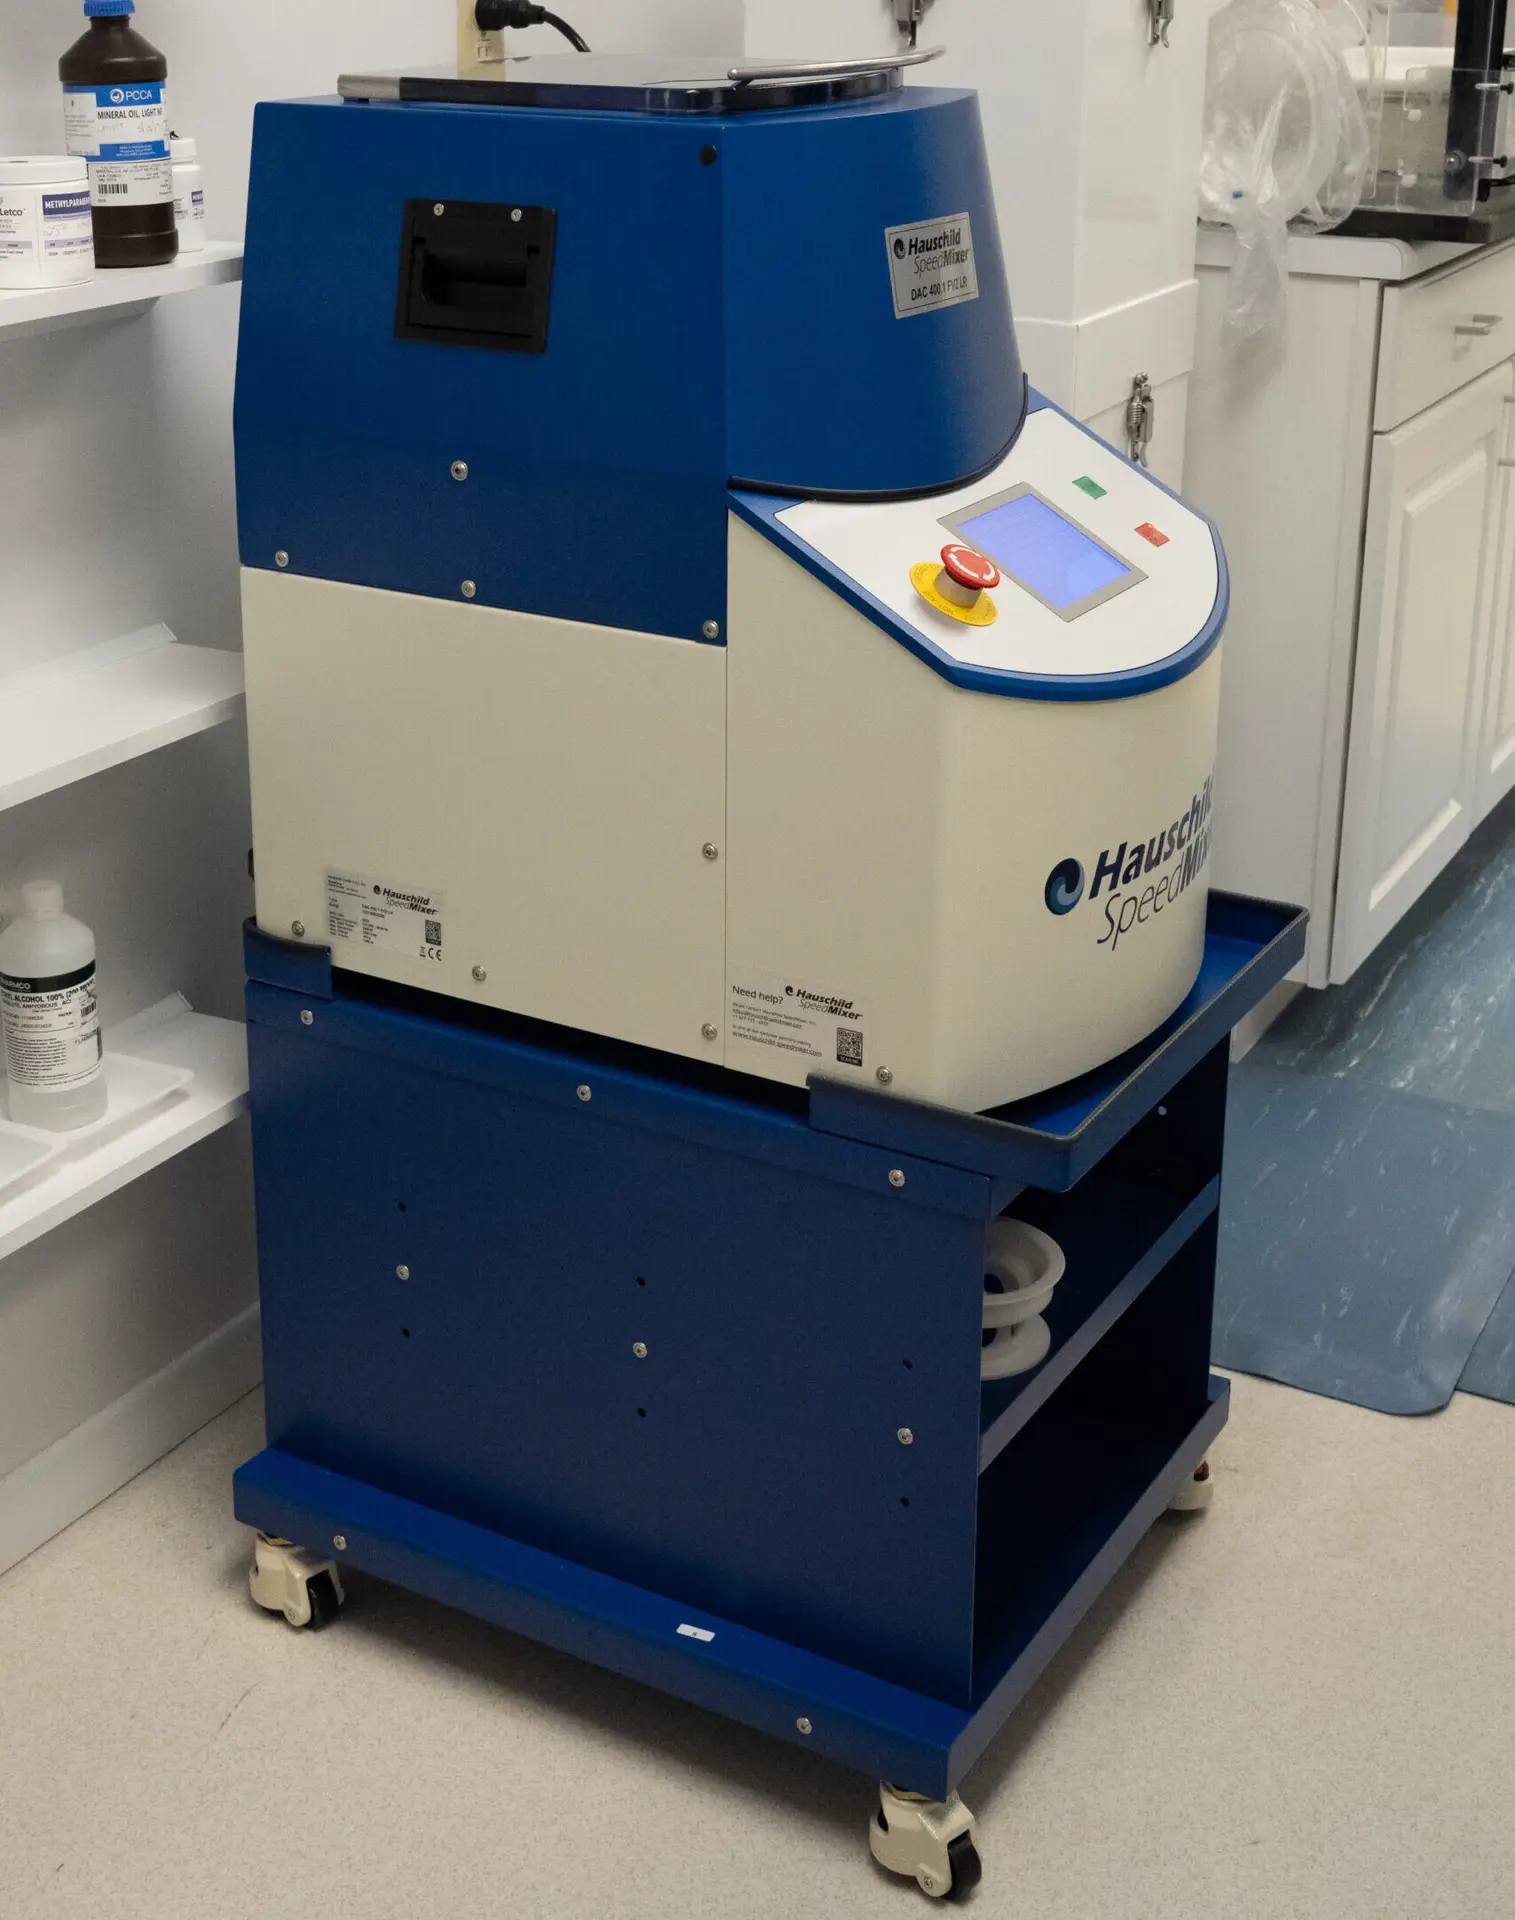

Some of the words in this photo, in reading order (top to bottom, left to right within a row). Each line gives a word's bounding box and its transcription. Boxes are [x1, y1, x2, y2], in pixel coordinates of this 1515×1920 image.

[125, 90, 153, 101] PCCA
[97, 110, 128, 120] MINERAL
[128, 109, 140, 119] OIL,
[0, 207, 23, 217] Letco
[908, 228, 961, 255] Hauschild
[913, 248, 969, 281] SpeedMixer
[911, 286, 928, 301] DAC
[959, 275, 968, 289] LR
[383, 888, 430, 905] Hauschild
[385, 897, 435, 915] SpeedMixer
[14, 994, 44, 1003] ALCOHOL
[732, 985, 757, 999] Need
[758, 990, 784, 1005] help?
[796, 989, 853, 1009] Hauschild
[798, 998, 861, 1020] SpeedMixer
